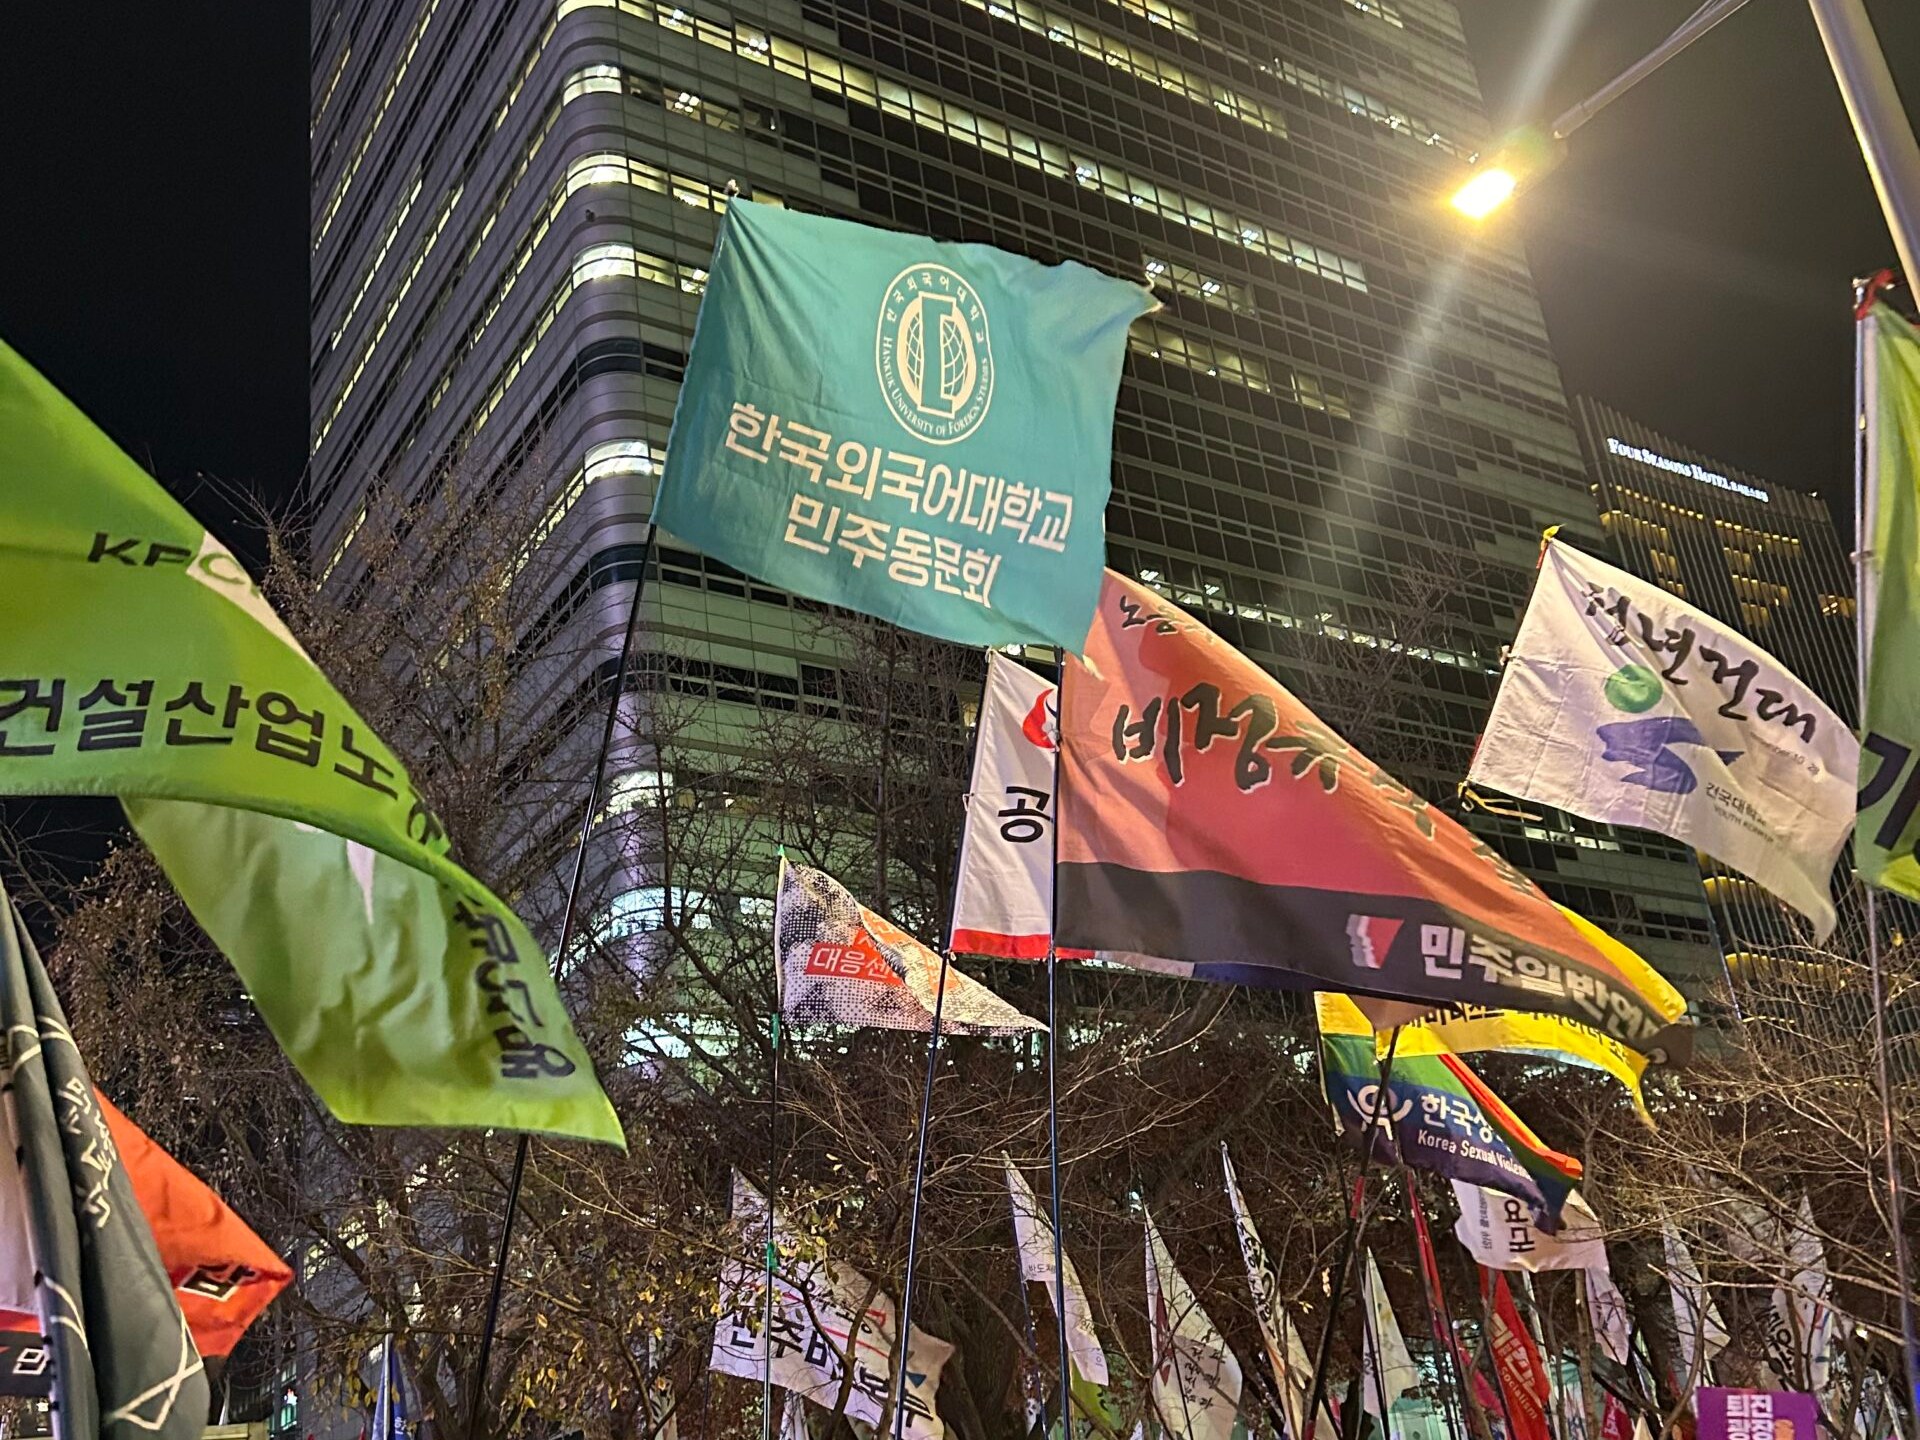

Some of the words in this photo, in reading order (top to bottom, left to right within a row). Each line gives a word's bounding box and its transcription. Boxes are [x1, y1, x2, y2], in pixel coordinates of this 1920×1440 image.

[886, 272, 984, 343] 한국외국어대학교
[891, 388, 933, 433] UNIVERSITY
[948, 406, 980, 434] FOREIGN
[725, 402, 1073, 553] 한국외국어대학교
[1607, 437, 1642, 462] FOUR
[1641, 449, 1692, 477] SEASONS
[1691, 464, 1731, 491] HOTEL
[87, 531, 256, 594] KFC
[784, 492, 1002, 609] 민주동문회
[998, 786, 1053, 843] 공
[812, 946, 898, 979] 대응센
[1421, 1093, 1503, 1144] 한국성
[1418, 1129, 1457, 1154] Korea
[1460, 1140, 1498, 1166] Sexual
[1500, 1366, 1538, 1420] Socialism
